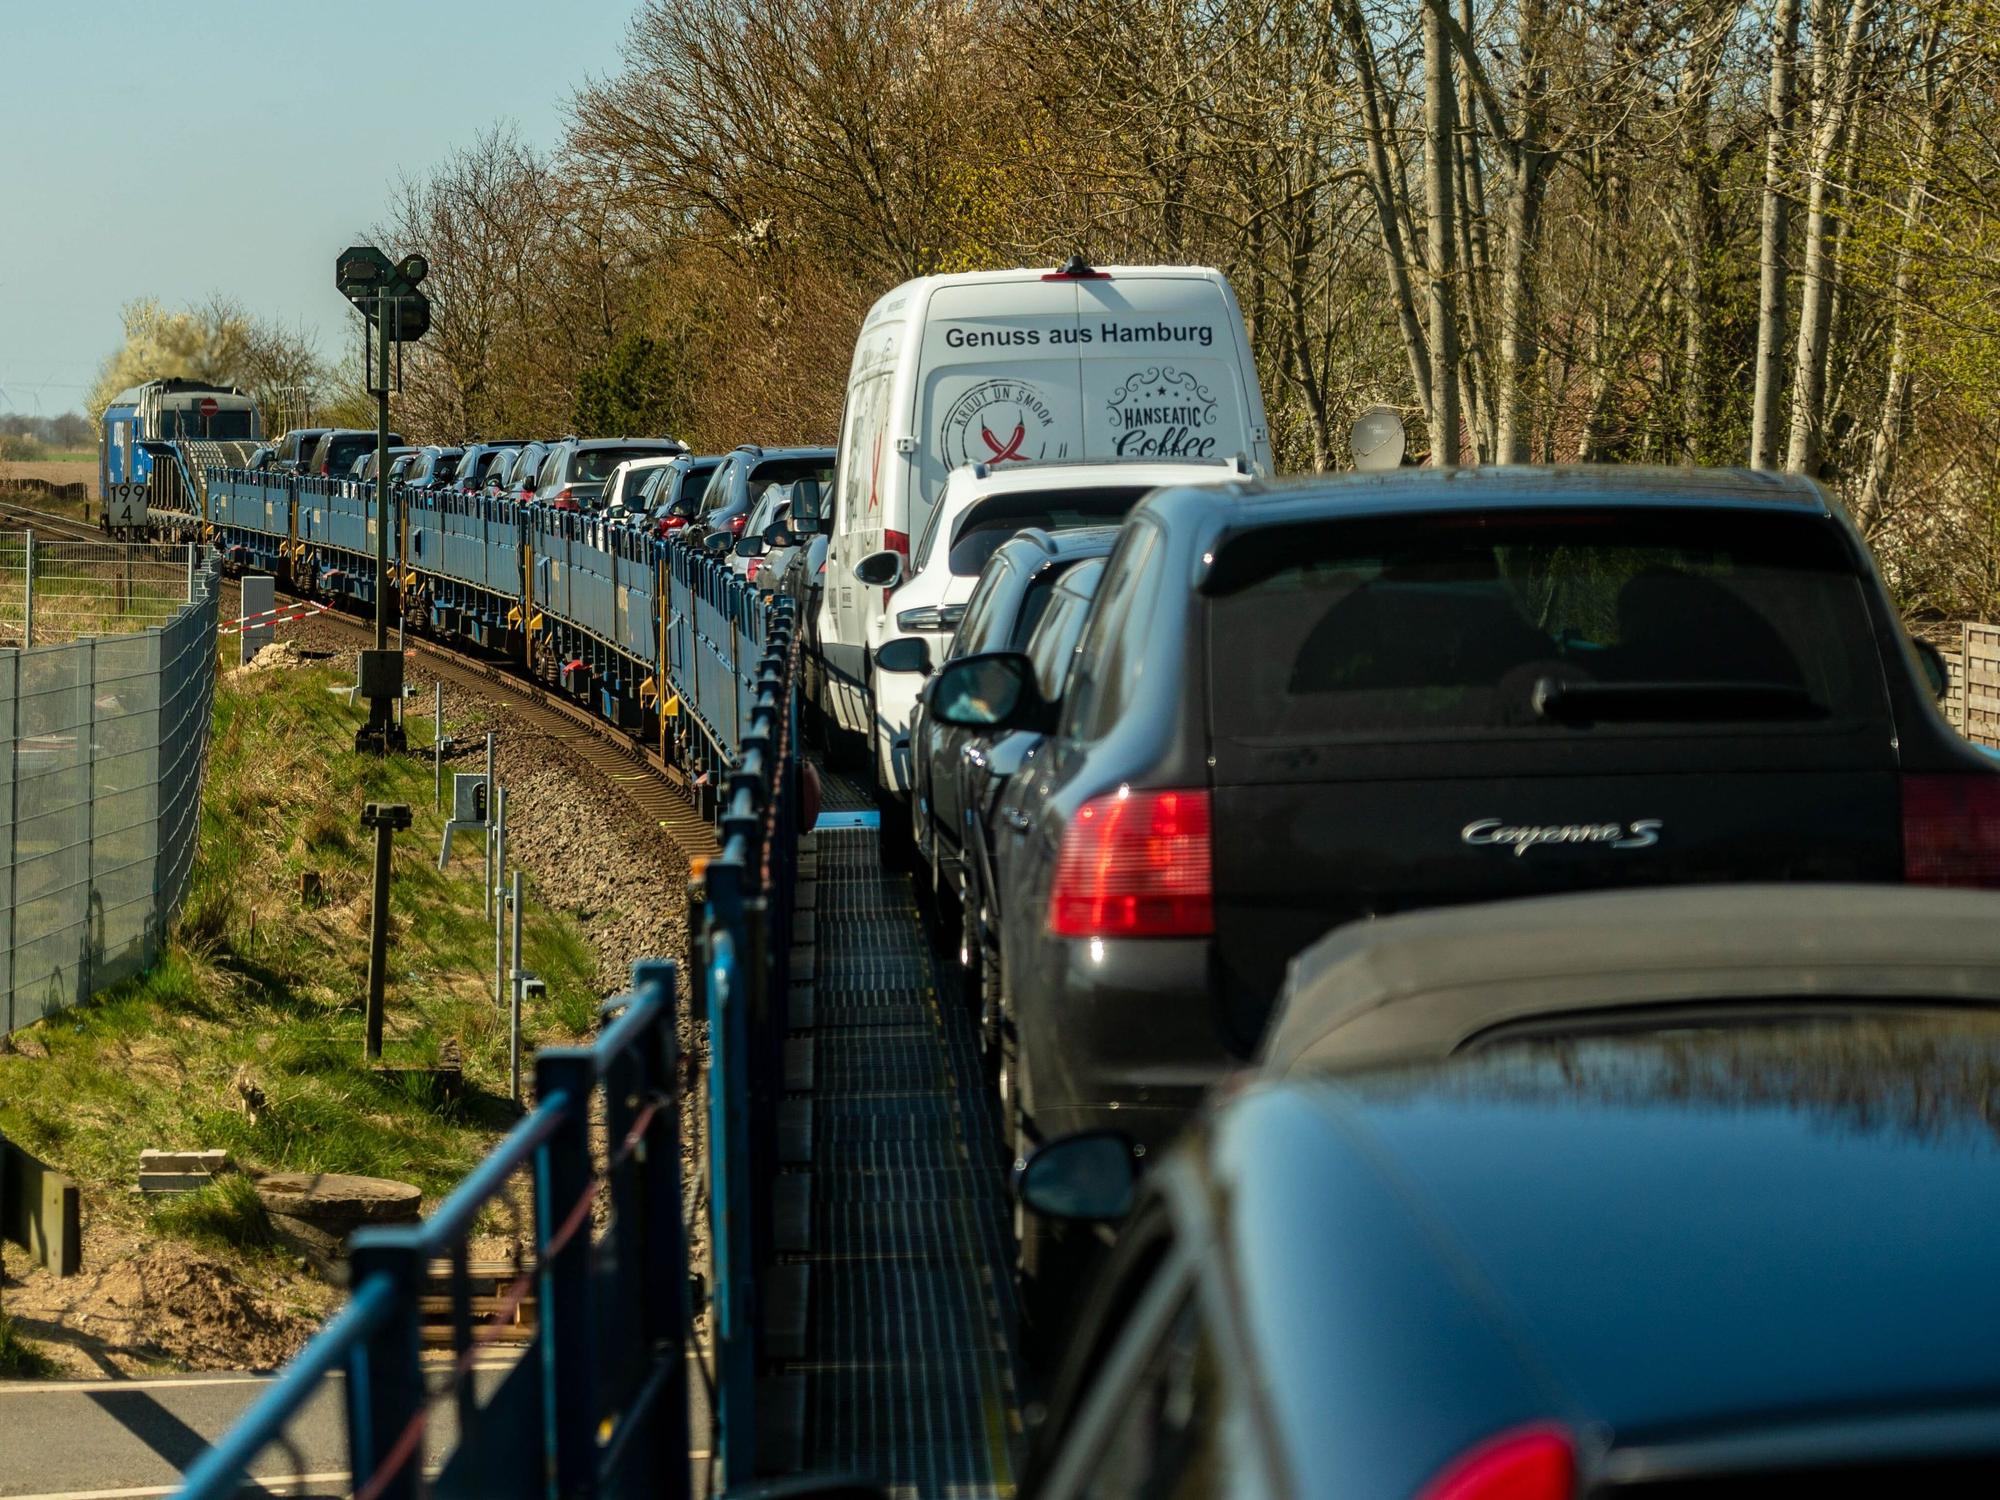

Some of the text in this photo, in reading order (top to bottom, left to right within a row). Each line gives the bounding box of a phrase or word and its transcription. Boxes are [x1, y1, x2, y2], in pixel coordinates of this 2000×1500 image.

[946, 322, 1213, 348] Genuss aus Hamburg
[954, 387, 1054, 427] KRUUT UN SMOOK
[1125, 407, 1201, 430] HANSEATIC
[1112, 427, 1215, 457] Coffee
[110, 485, 145, 503] 199
[121, 505, 133, 521] 4
[1461, 818, 1663, 857] Cayenne S
